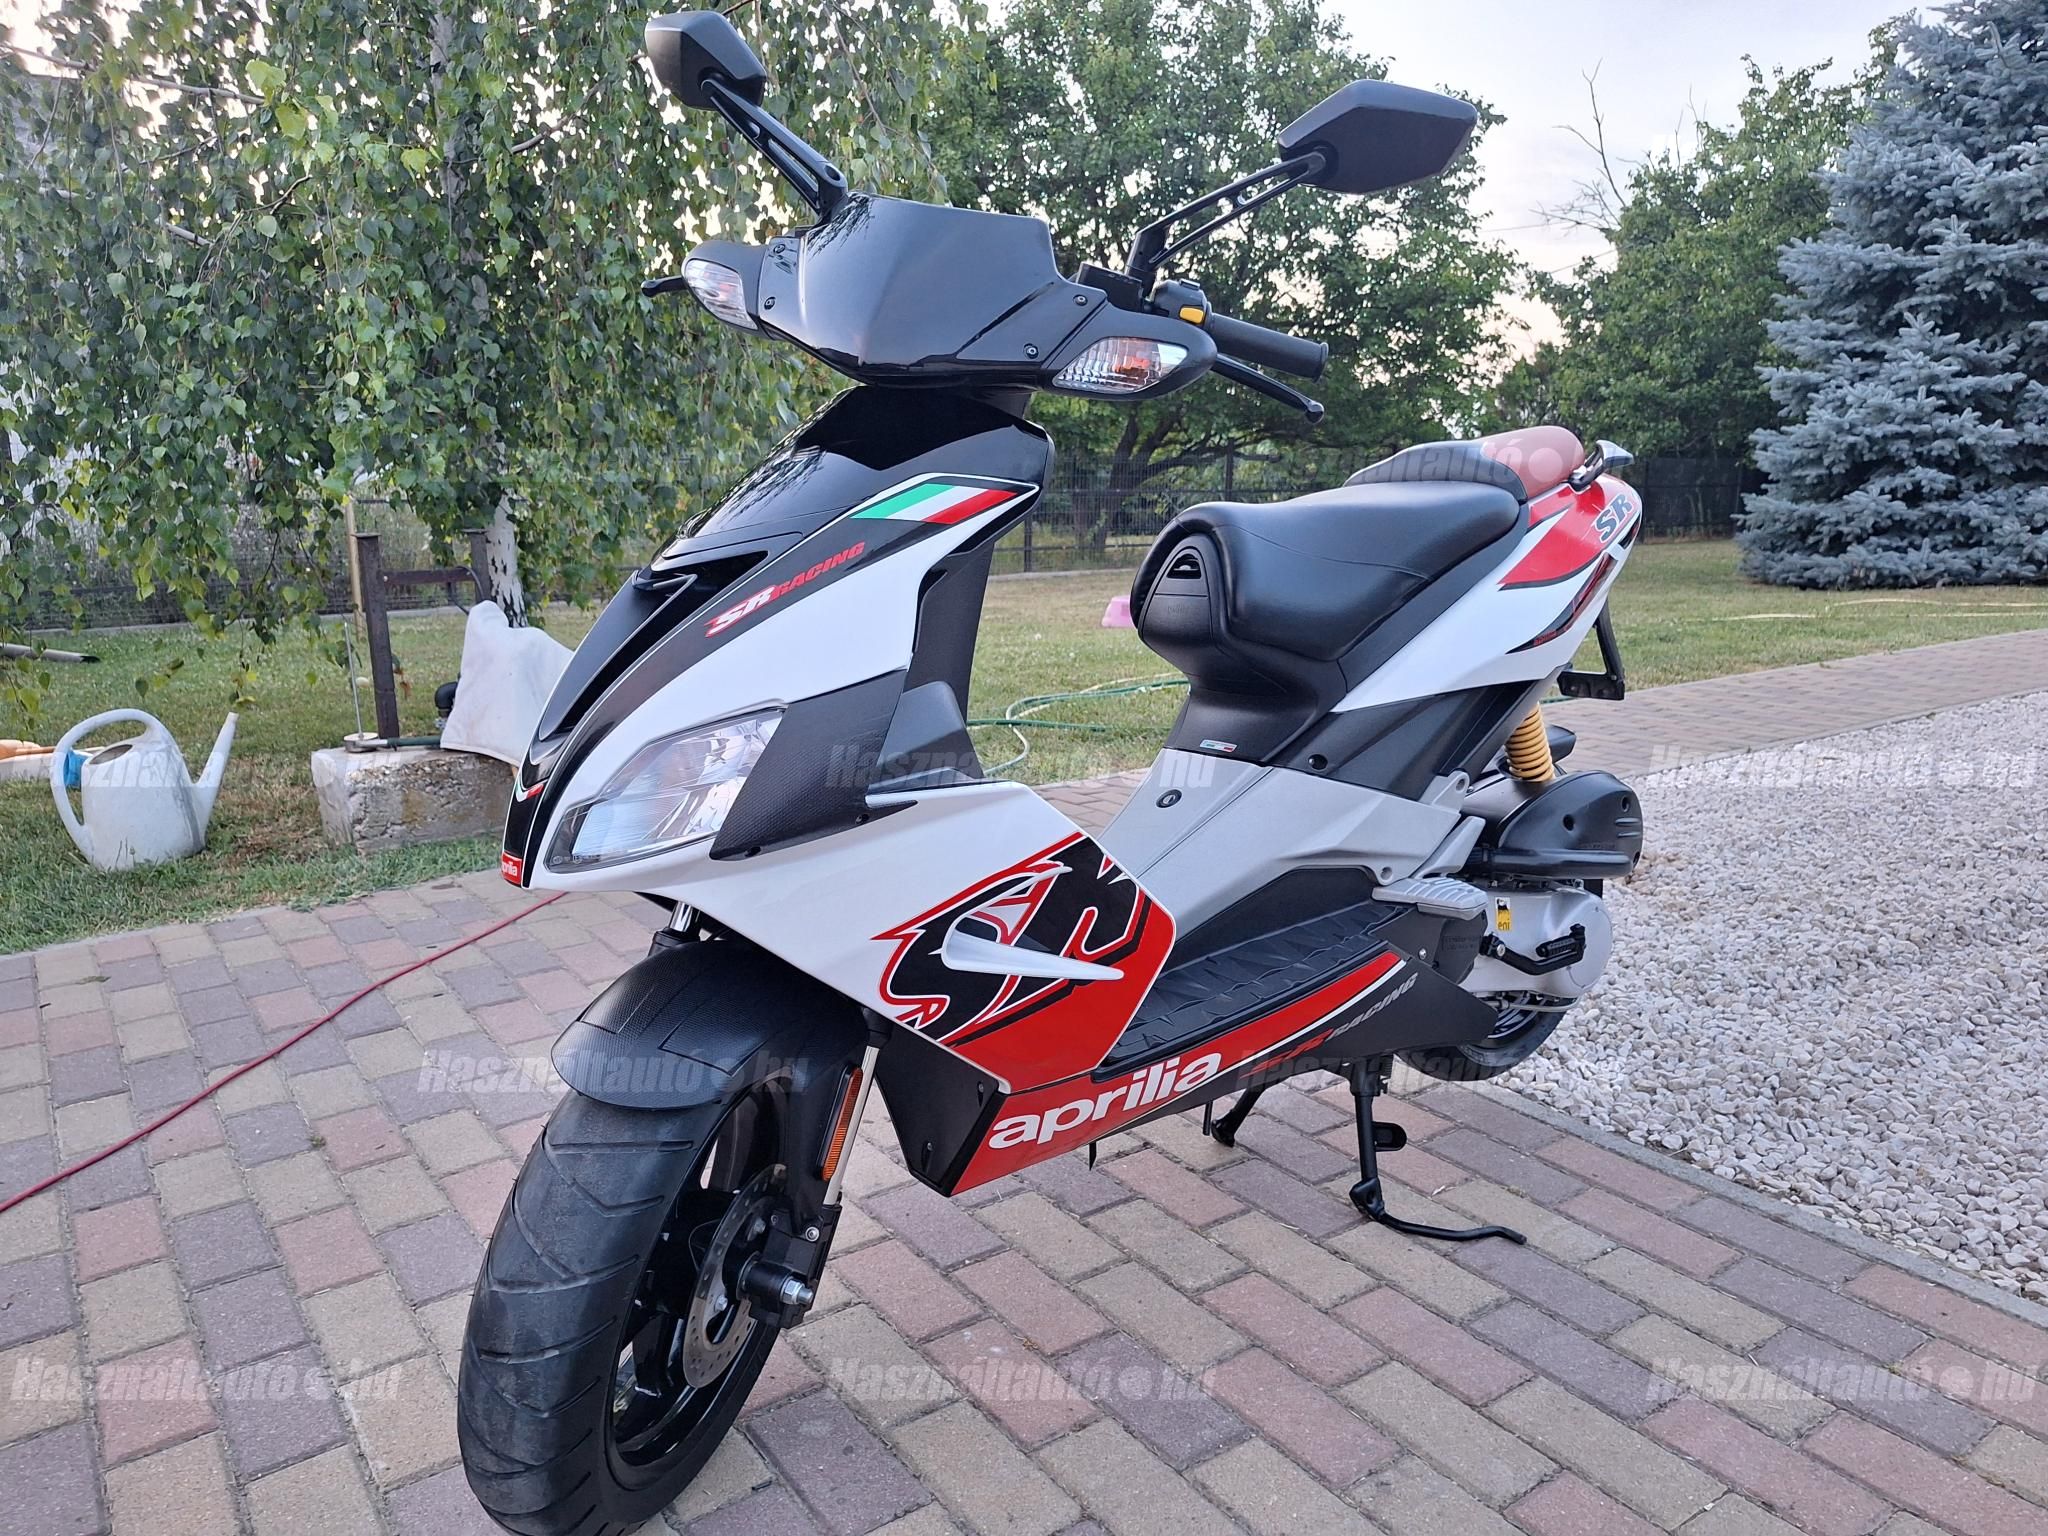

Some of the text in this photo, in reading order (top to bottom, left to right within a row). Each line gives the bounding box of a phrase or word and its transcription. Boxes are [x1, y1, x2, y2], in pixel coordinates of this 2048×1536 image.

[1595, 493, 1634, 543] SR
[1497, 921, 1510, 931] eni
[988, 1052, 1222, 1149] aprilia
